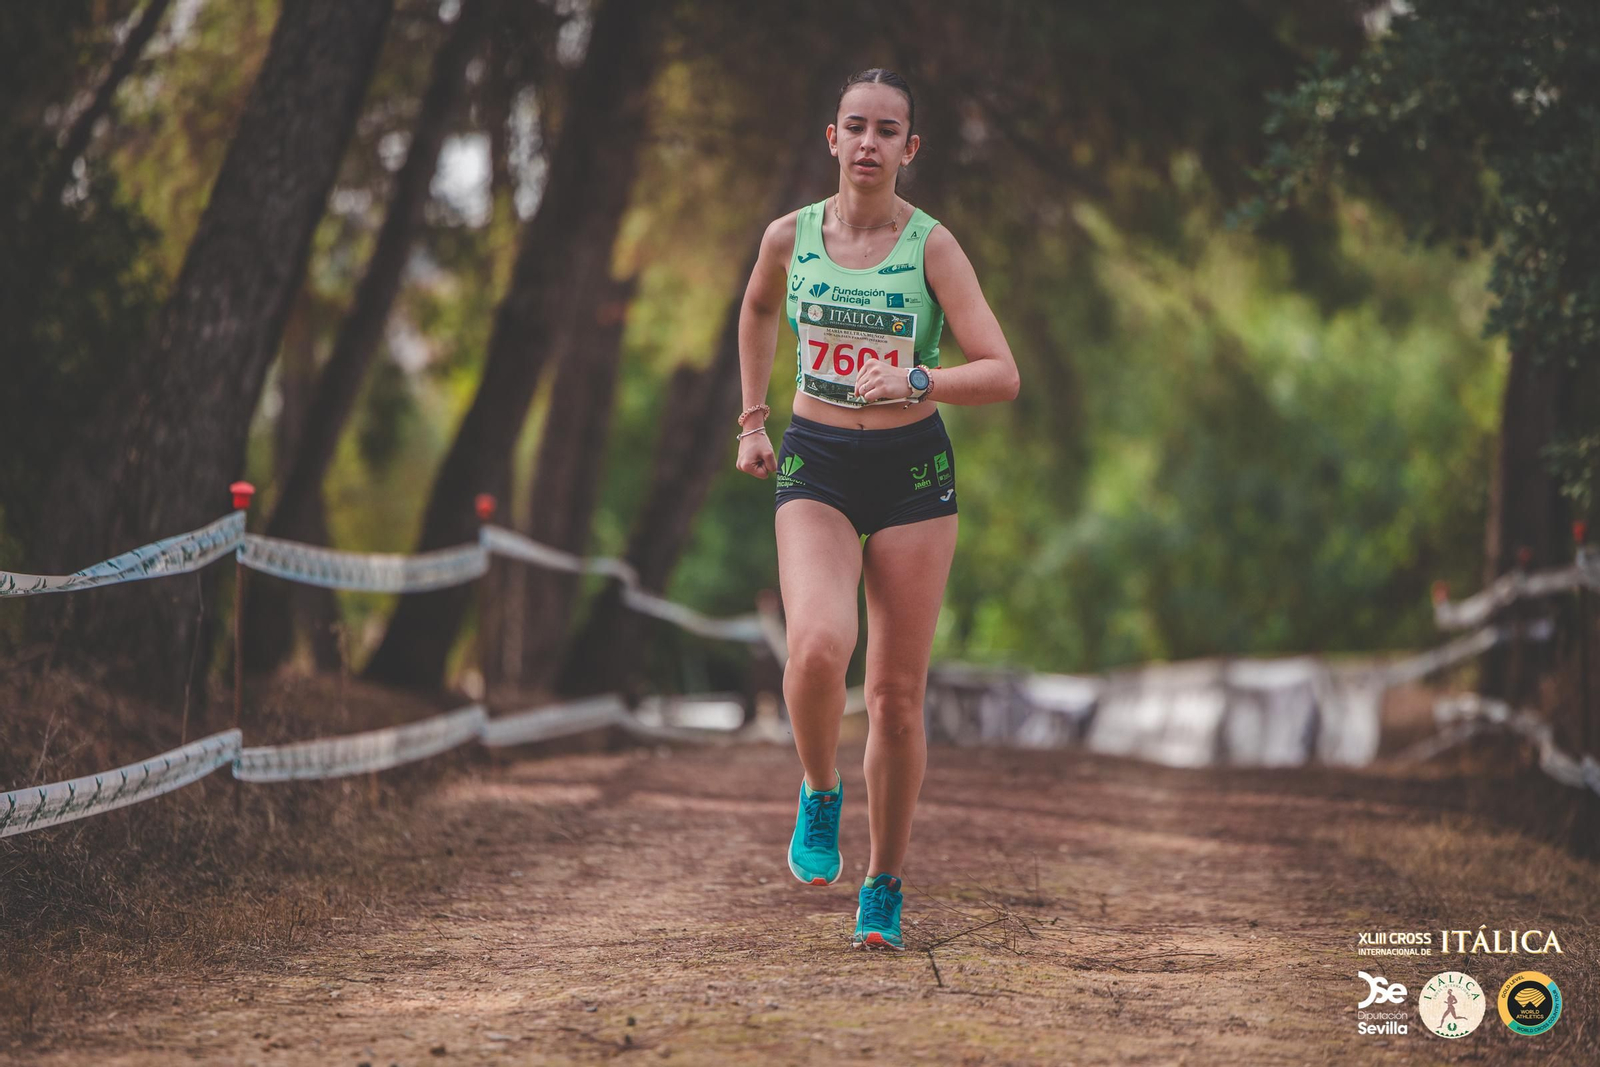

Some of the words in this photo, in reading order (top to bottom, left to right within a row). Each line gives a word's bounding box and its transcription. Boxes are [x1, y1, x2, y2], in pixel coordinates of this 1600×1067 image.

[833, 286, 885, 297] Fundación
[831, 294, 871, 306] Unicaja
[830, 309, 884, 327] ITÁLICA
[808, 340, 898, 376] 7601
